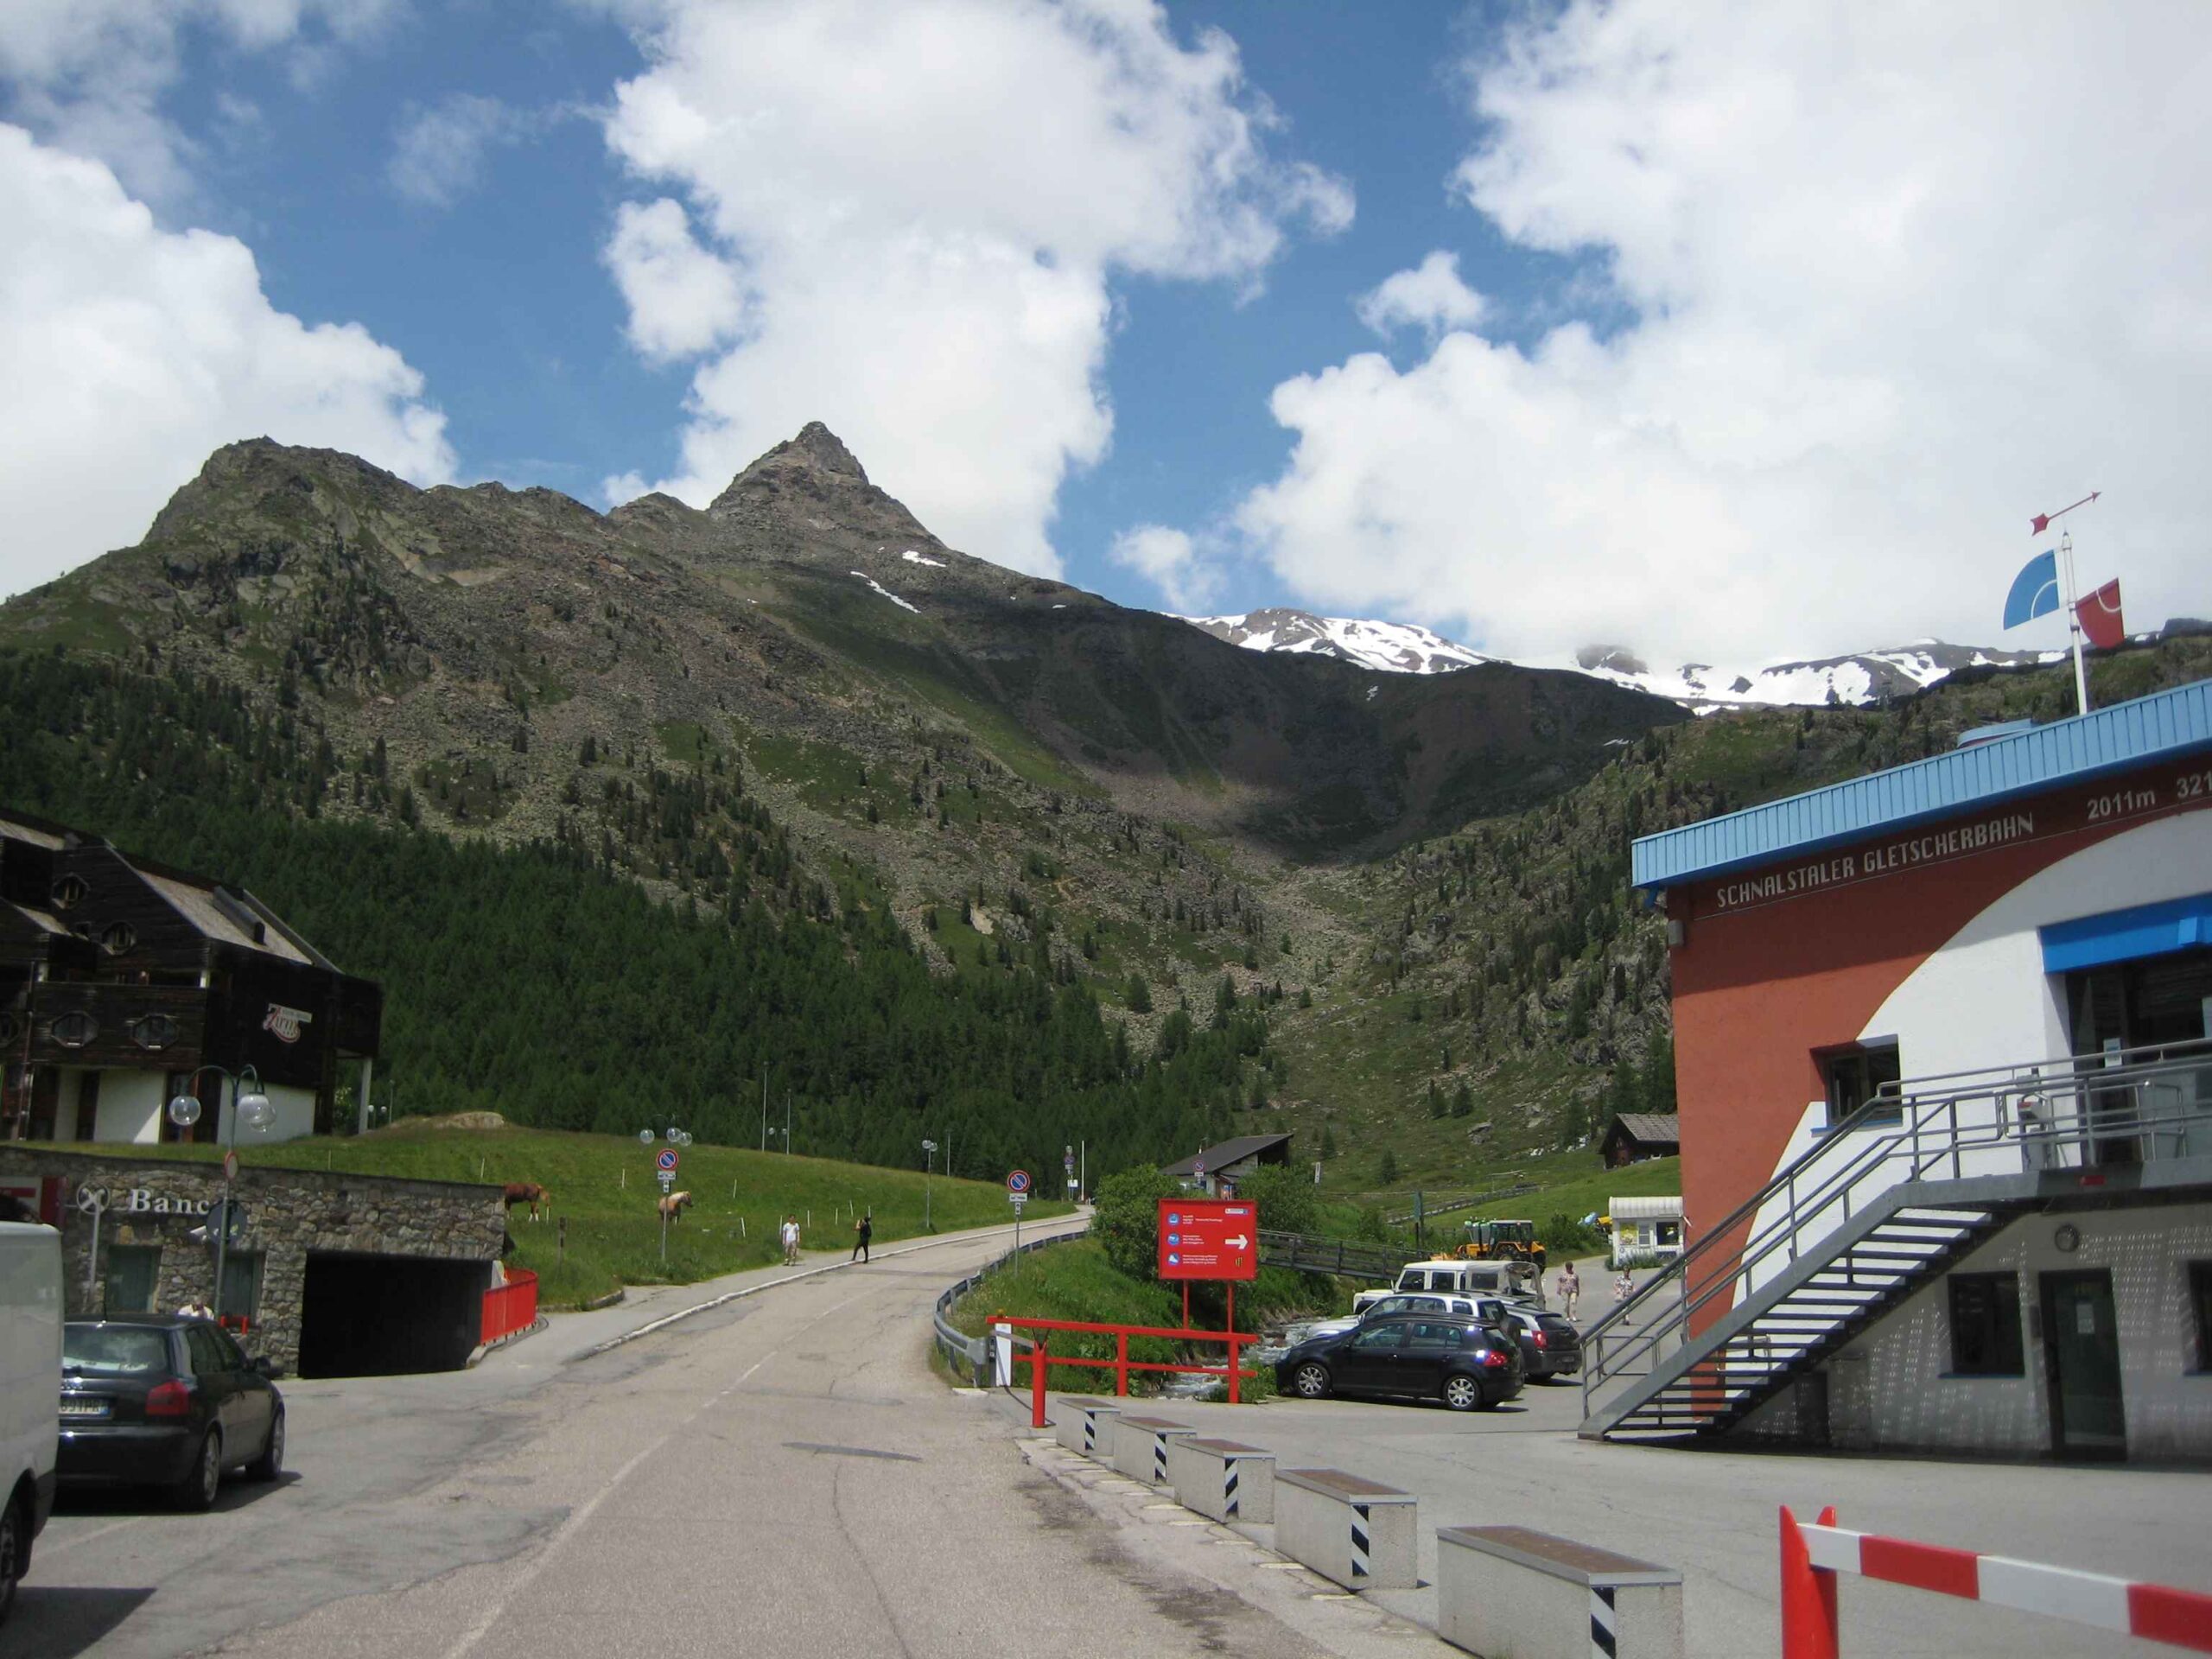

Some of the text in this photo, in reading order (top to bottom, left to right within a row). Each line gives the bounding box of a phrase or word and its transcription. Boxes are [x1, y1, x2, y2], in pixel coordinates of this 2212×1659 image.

[1717, 856, 1854, 908] SCHNALSTALER
[1864, 811, 2033, 873] GLETSCHERBAHN
[2088, 791, 2155, 820] 2011m
[130, 1188, 210, 1215] Banc
